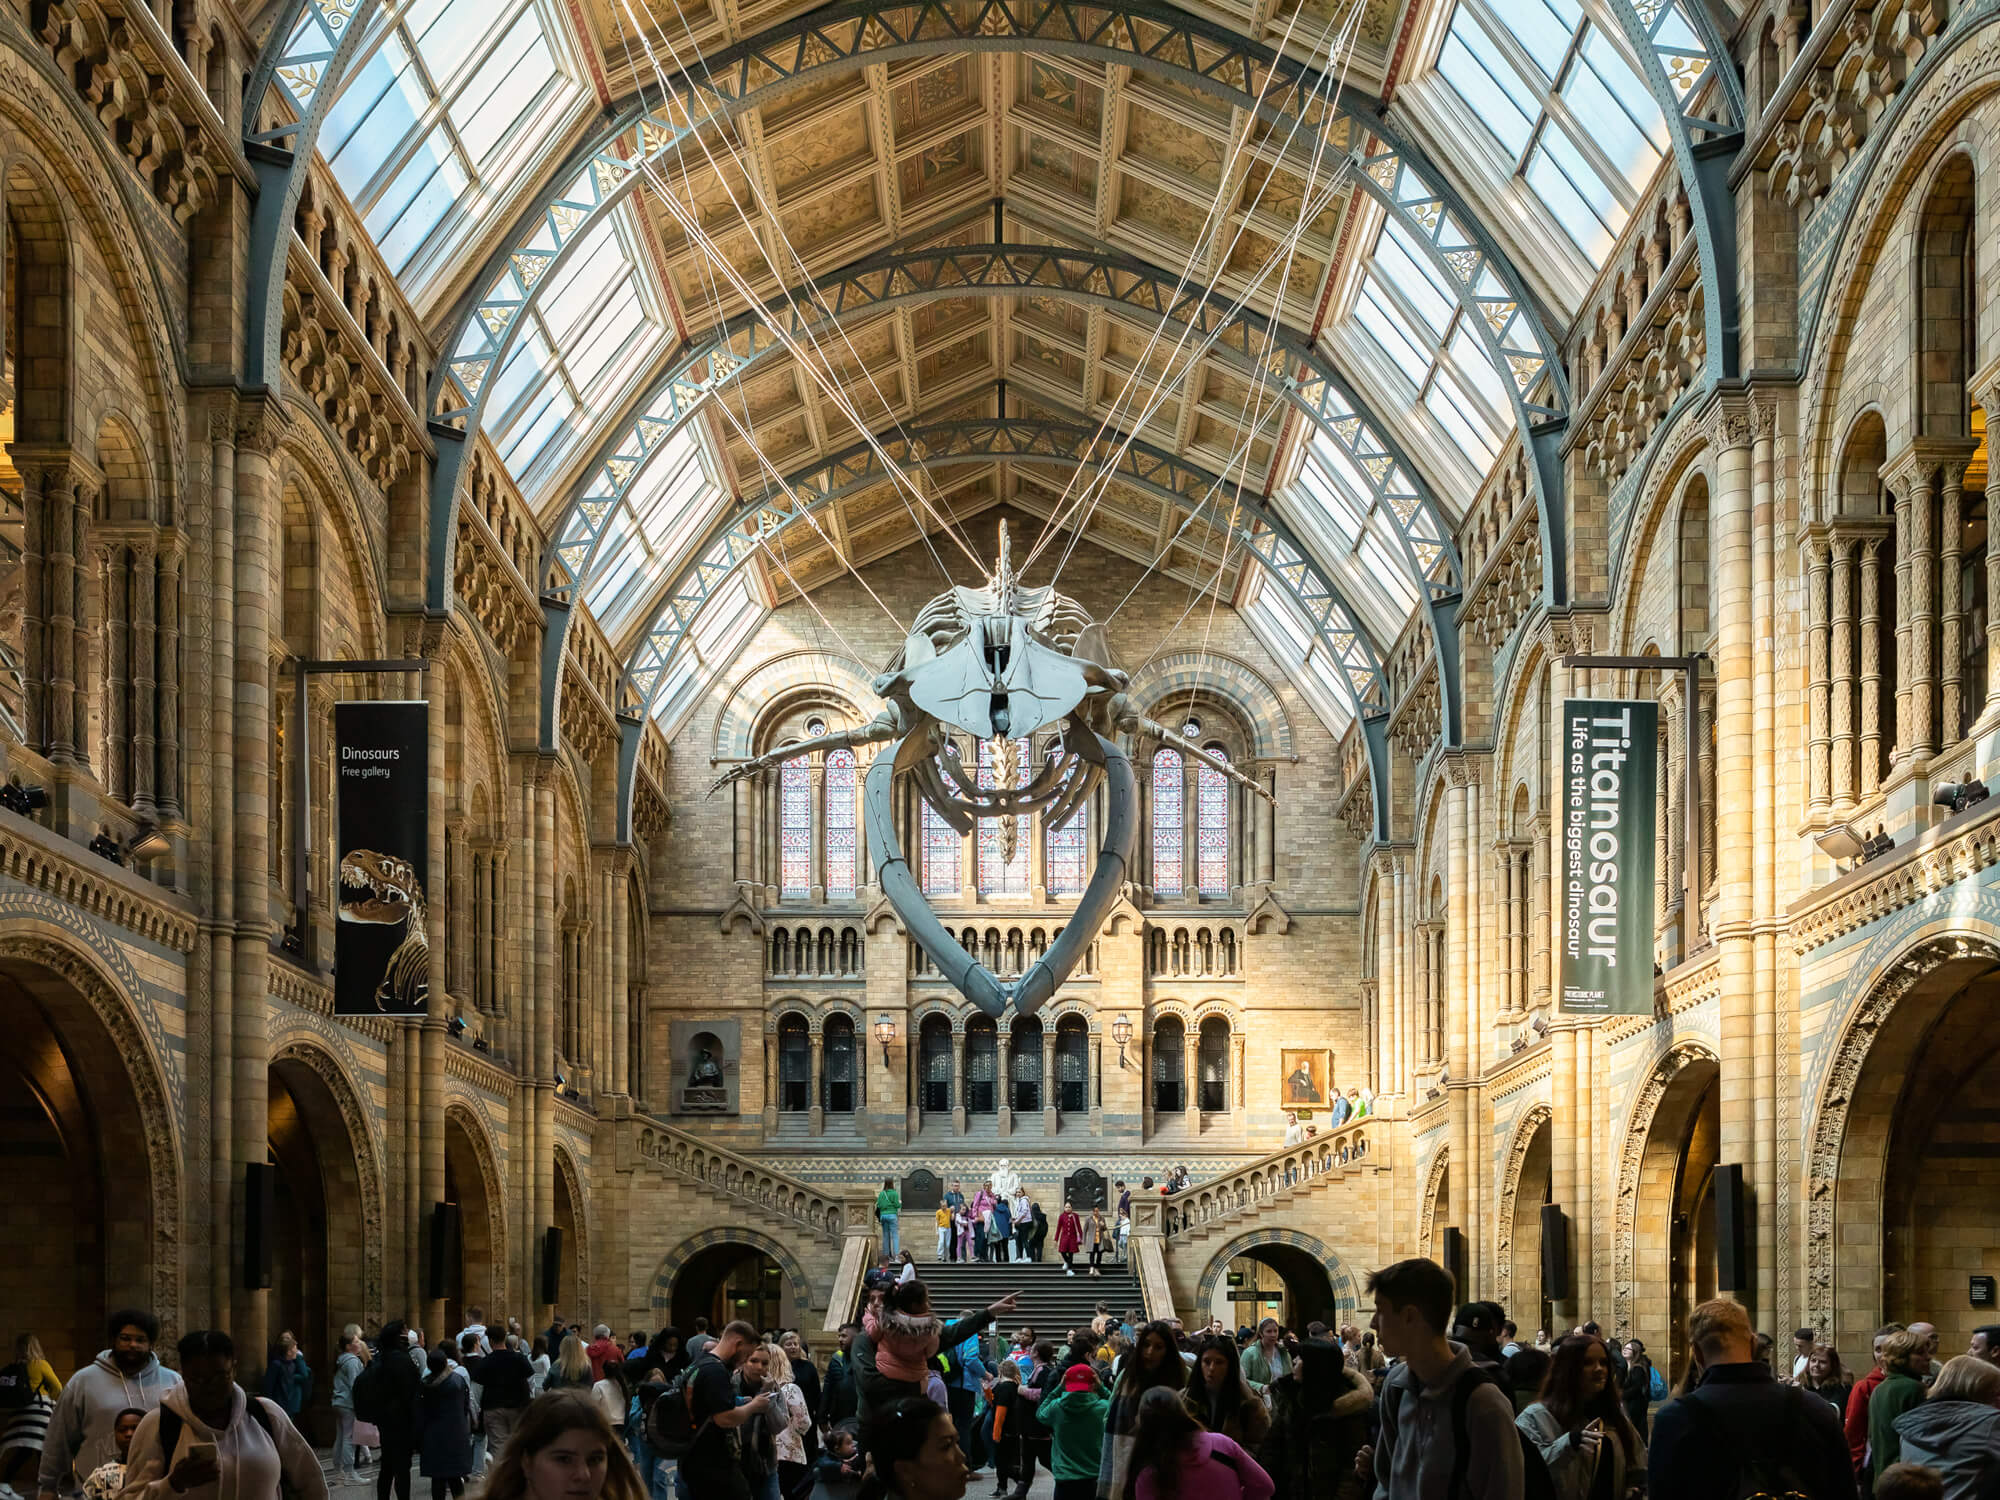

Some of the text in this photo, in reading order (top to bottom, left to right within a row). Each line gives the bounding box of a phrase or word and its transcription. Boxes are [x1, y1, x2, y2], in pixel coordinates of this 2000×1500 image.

[342, 746, 400, 760] Dinosaurs
[342, 766, 391, 779] Free gallery
[1567, 717, 1588, 960] Life as the biggest dinosaur
[1588, 707, 1631, 967] Titanosaur
